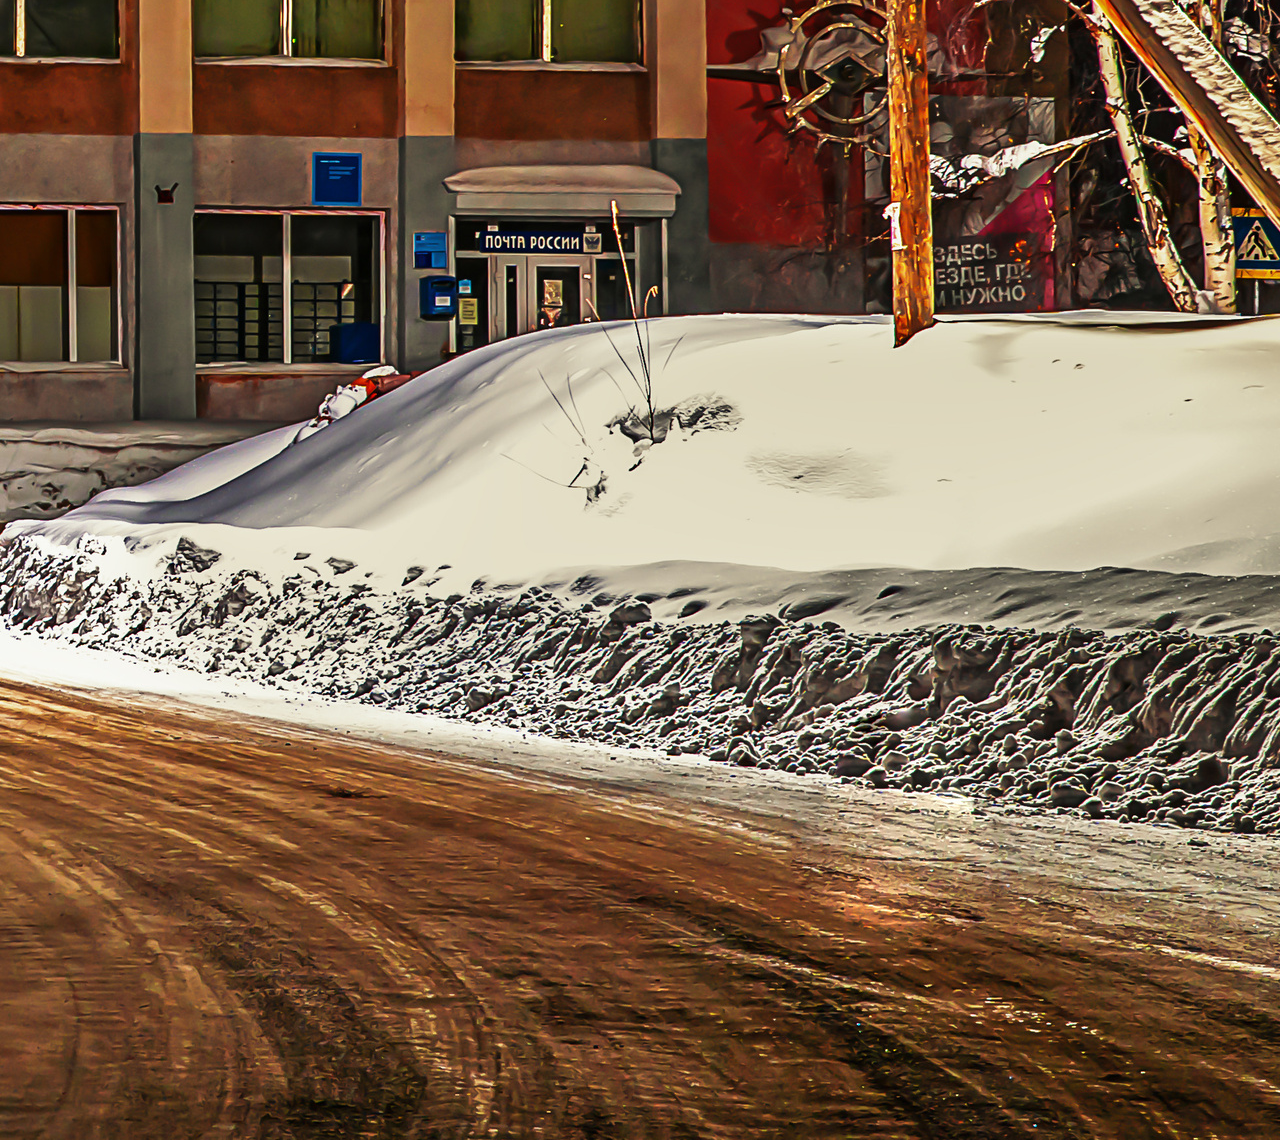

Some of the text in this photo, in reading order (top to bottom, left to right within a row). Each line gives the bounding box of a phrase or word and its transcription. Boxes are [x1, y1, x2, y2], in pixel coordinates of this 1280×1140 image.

[485, 235, 580, 250] ПОЧТА РОССИИ
[933, 242, 998, 266] ЗДЕСЬ
[935, 265, 991, 287] ЕЗДЕ,
[951, 284, 1027, 306] НУЖНО
